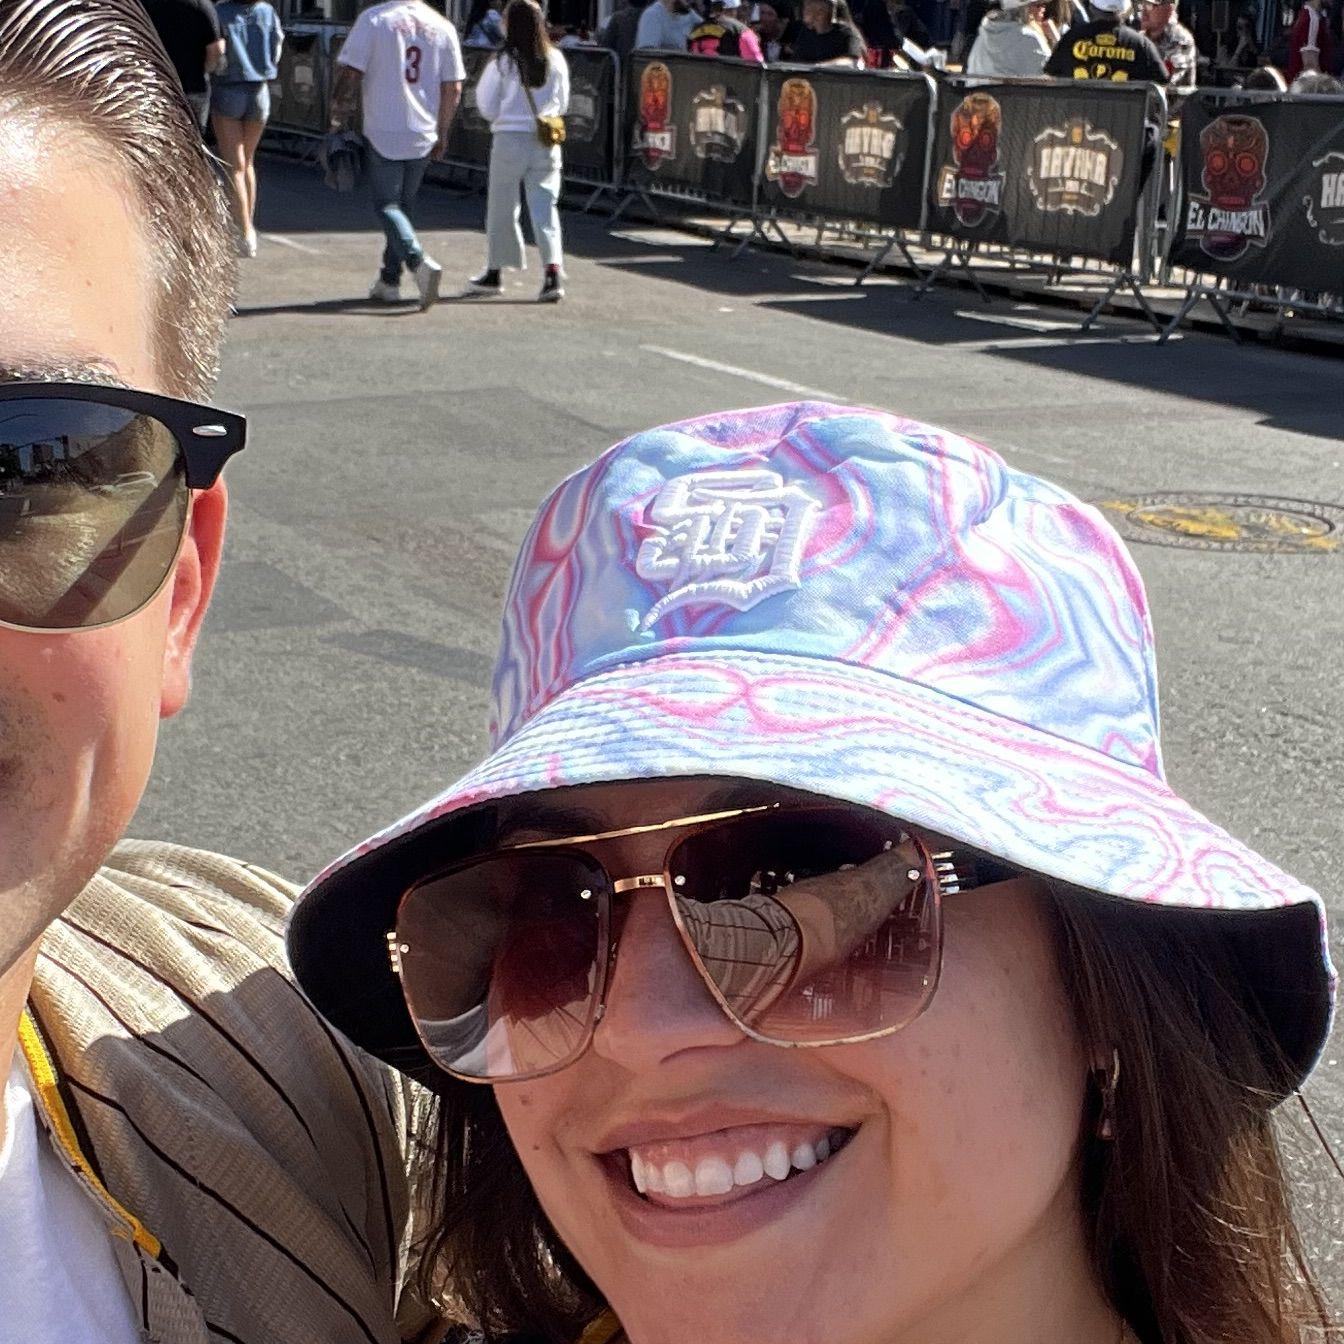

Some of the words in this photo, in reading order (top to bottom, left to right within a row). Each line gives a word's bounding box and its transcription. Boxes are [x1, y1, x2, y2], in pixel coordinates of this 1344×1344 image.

[405, 46, 421, 83] 3
[1073, 40, 1135, 61] Corona
[1187, 201, 1205, 231] EL
[1207, 208, 1265, 238] CHINGON
